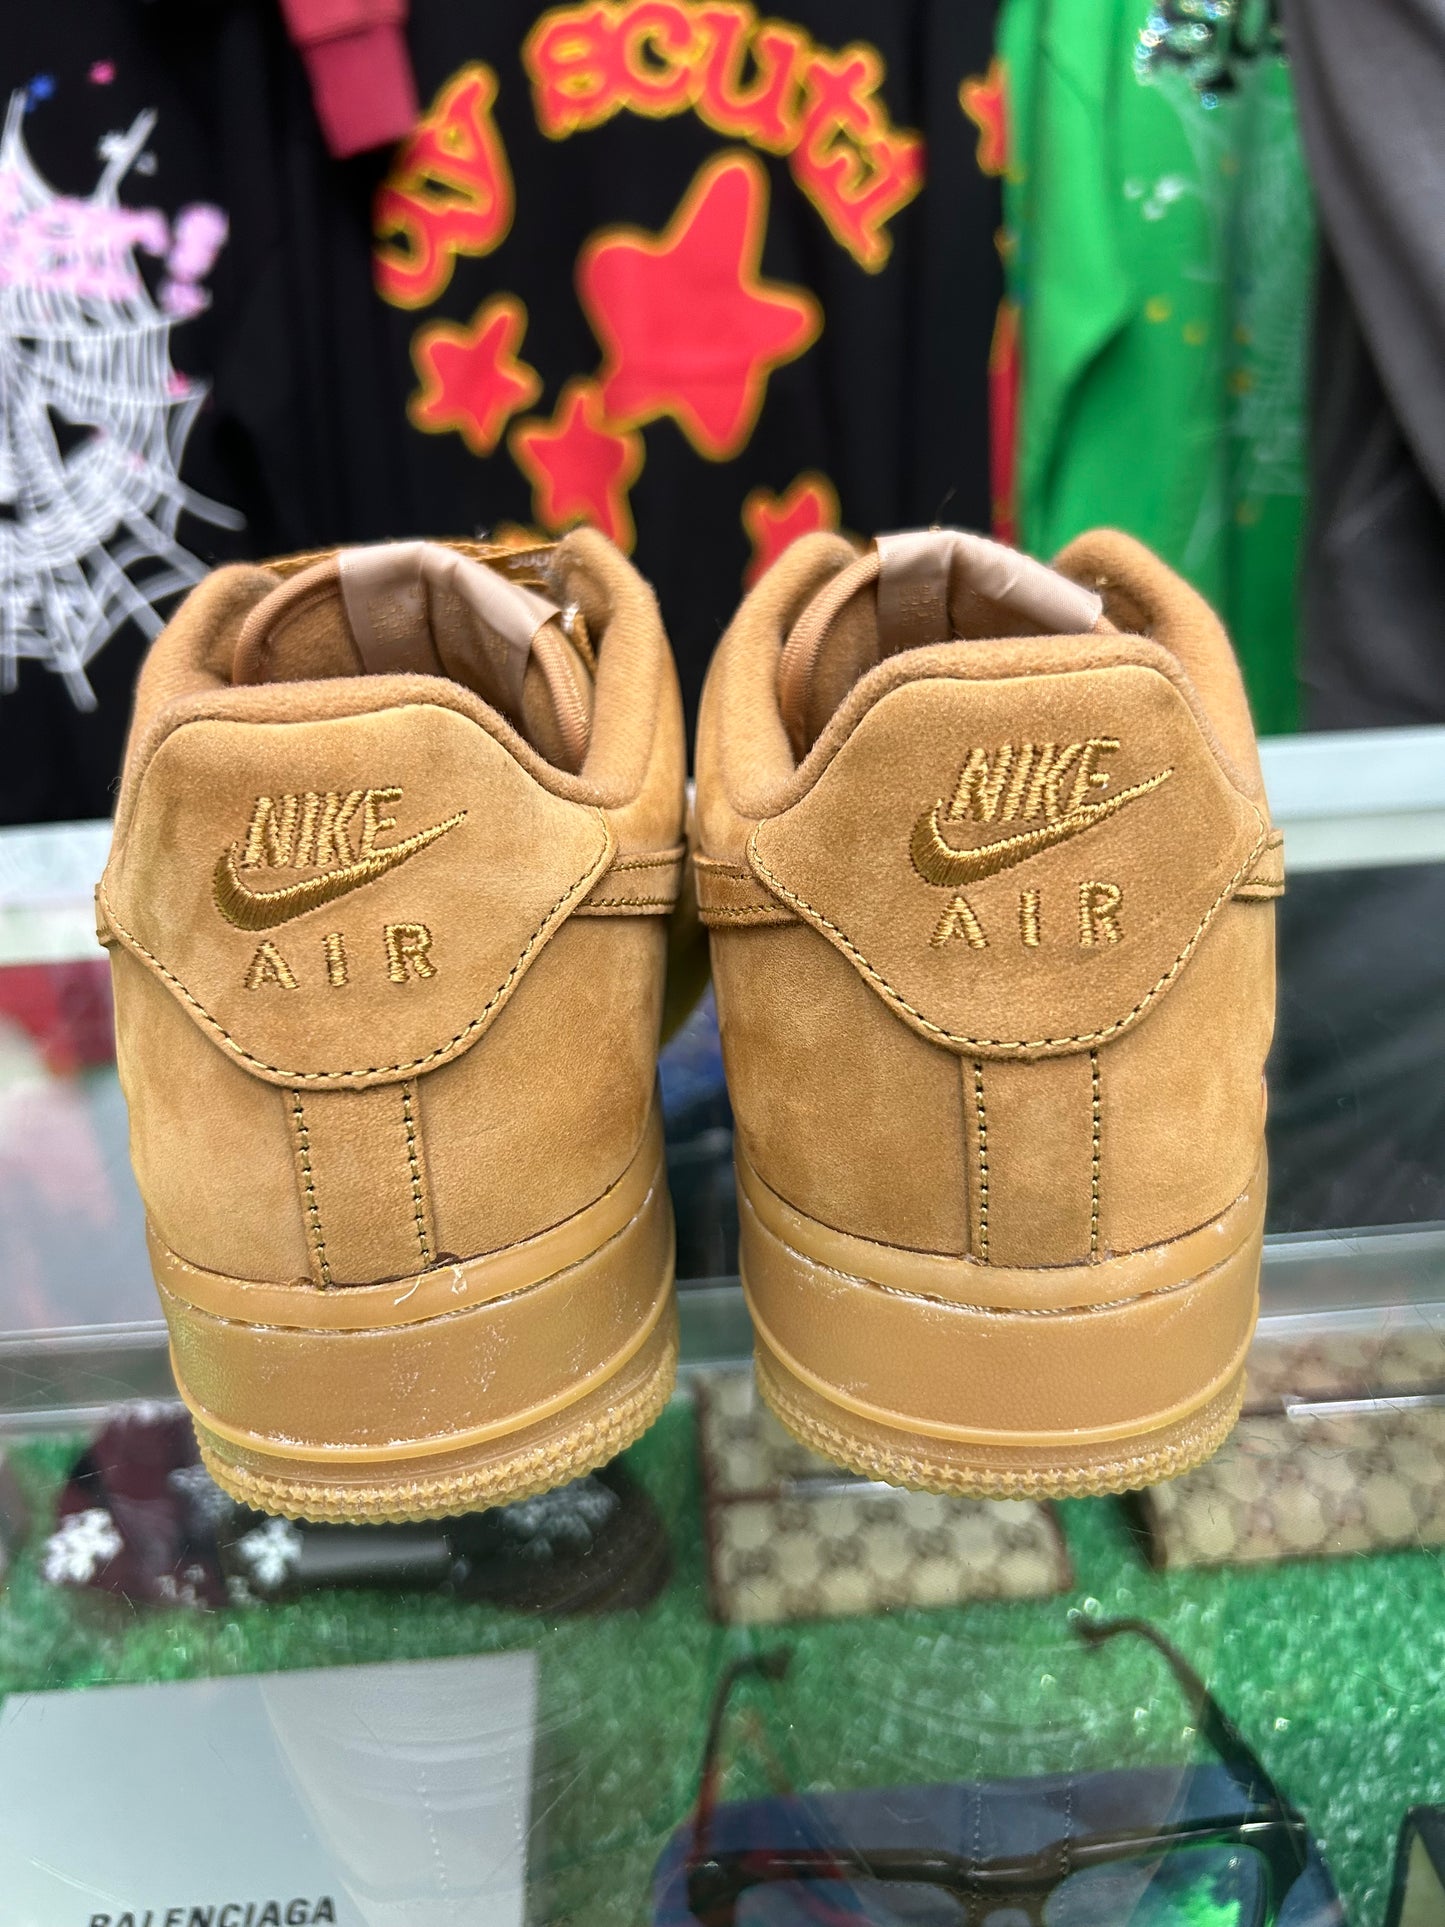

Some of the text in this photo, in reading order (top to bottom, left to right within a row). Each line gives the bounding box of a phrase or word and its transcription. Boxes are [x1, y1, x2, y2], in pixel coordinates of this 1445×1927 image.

[944, 737, 1120, 823] NIKE
[242, 786, 403, 868] NIKE
[929, 881, 1124, 950] AIR
[244, 923, 438, 990] AIR
